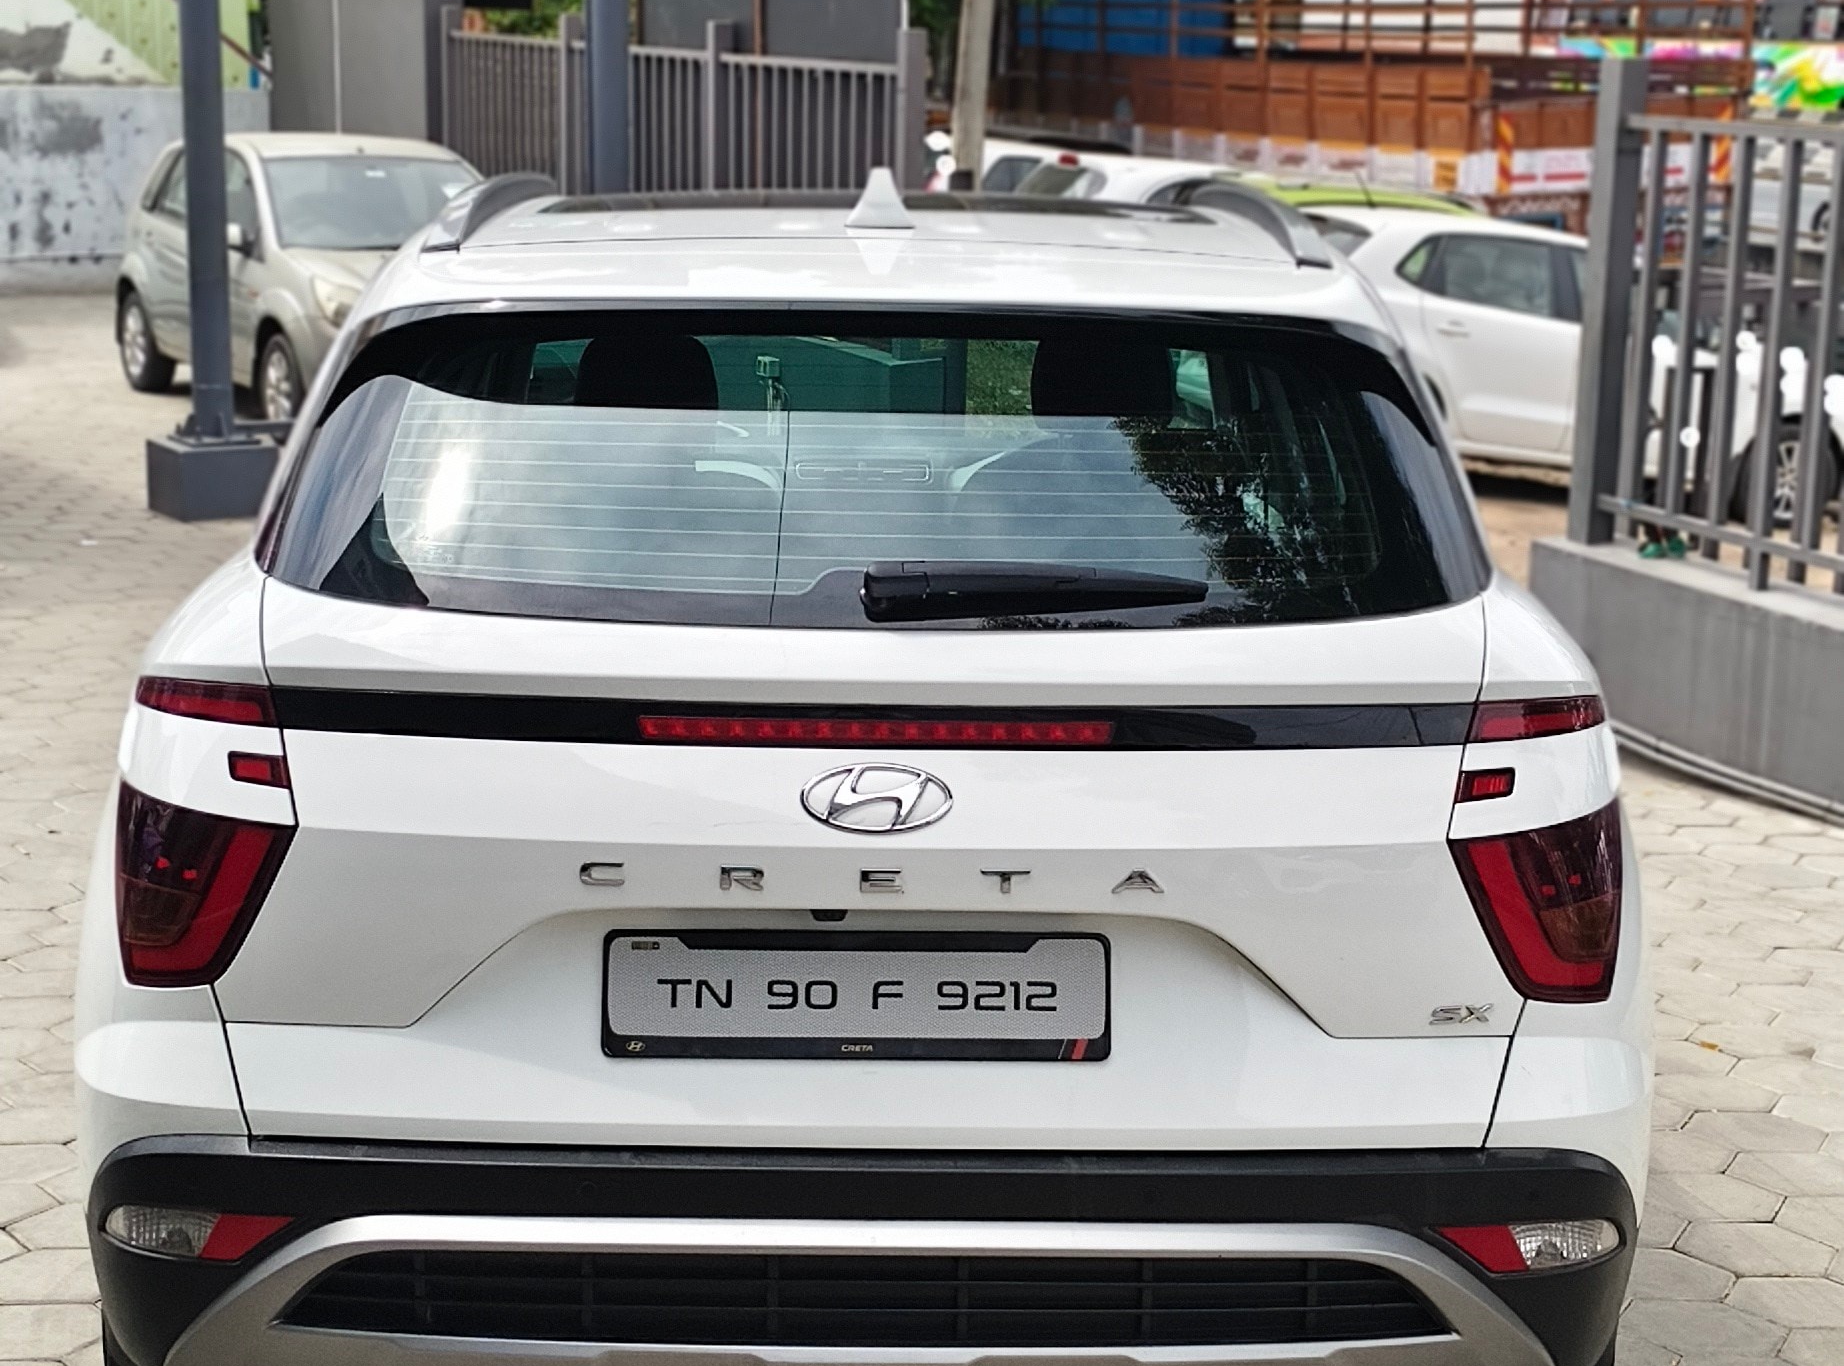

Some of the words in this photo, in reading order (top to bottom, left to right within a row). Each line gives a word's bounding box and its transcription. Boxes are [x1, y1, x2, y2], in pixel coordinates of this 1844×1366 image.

[579, 861, 1165, 895] CRETA
[656, 978, 733, 1009] TN
[766, 979, 838, 1010] 90
[871, 980, 904, 1010] F
[937, 980, 1058, 1011] 9212
[1428, 1002, 1494, 1025] SX
[840, 1044, 874, 1052] CRETA
